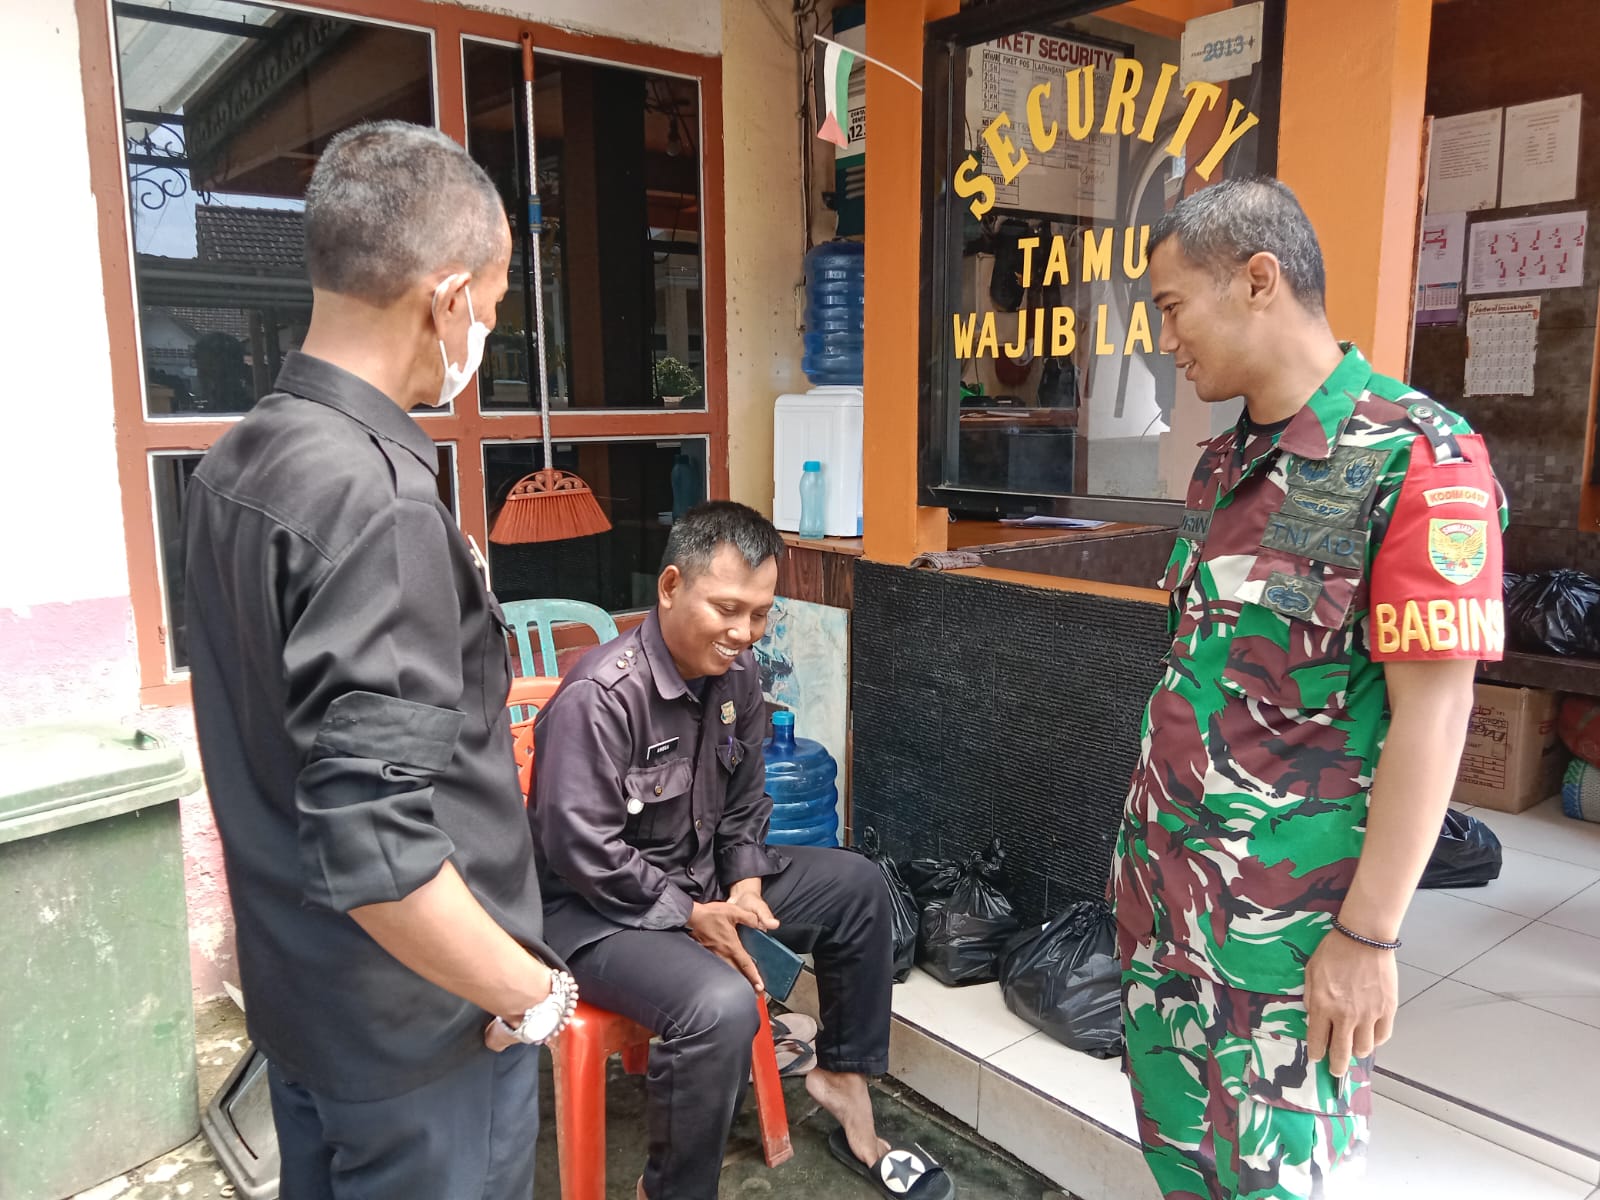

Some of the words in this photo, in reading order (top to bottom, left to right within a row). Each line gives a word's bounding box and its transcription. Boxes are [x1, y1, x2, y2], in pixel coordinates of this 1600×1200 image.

[986, 32, 1034, 55] IKET
[1038, 37, 1114, 71] SECURITY
[953, 58, 1260, 222] SECURITY
[1017, 224, 1150, 288] TAMU
[953, 306, 1076, 360] WAJIB
[1095, 301, 1168, 356] LA
[1271, 520, 1311, 549] TNI
[1317, 534, 1356, 556] AD
